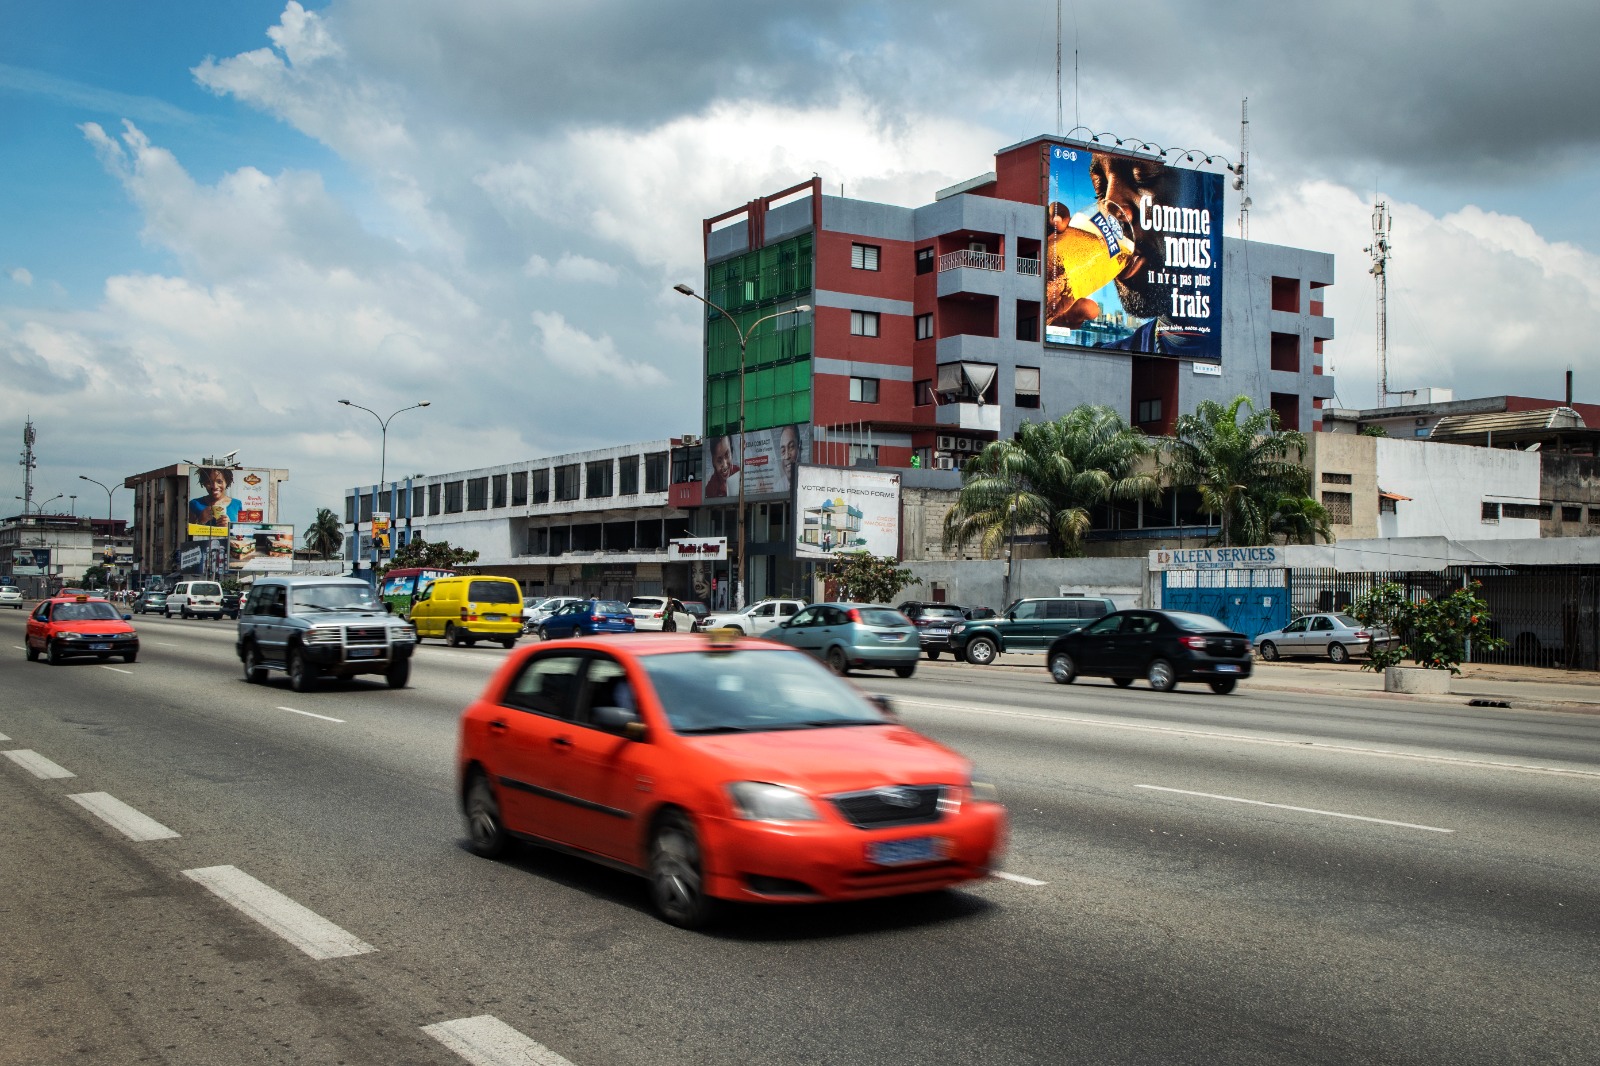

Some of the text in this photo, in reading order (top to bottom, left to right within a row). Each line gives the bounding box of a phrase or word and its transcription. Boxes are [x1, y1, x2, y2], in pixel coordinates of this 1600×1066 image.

[1140, 195, 1210, 234] Comme
[1094, 215, 1118, 253] IVOIRE
[1164, 236, 1211, 269] nous
[1148, 268, 1211, 288] il n'y a pas plus
[1171, 287, 1210, 318] frais
[802, 484, 826, 492] VOTRE
[846, 488, 870, 497] PREND
[870, 491, 896, 499] FORME
[1173, 550, 1212, 563] KLEEN
[1217, 547, 1276, 561] SERVICES
